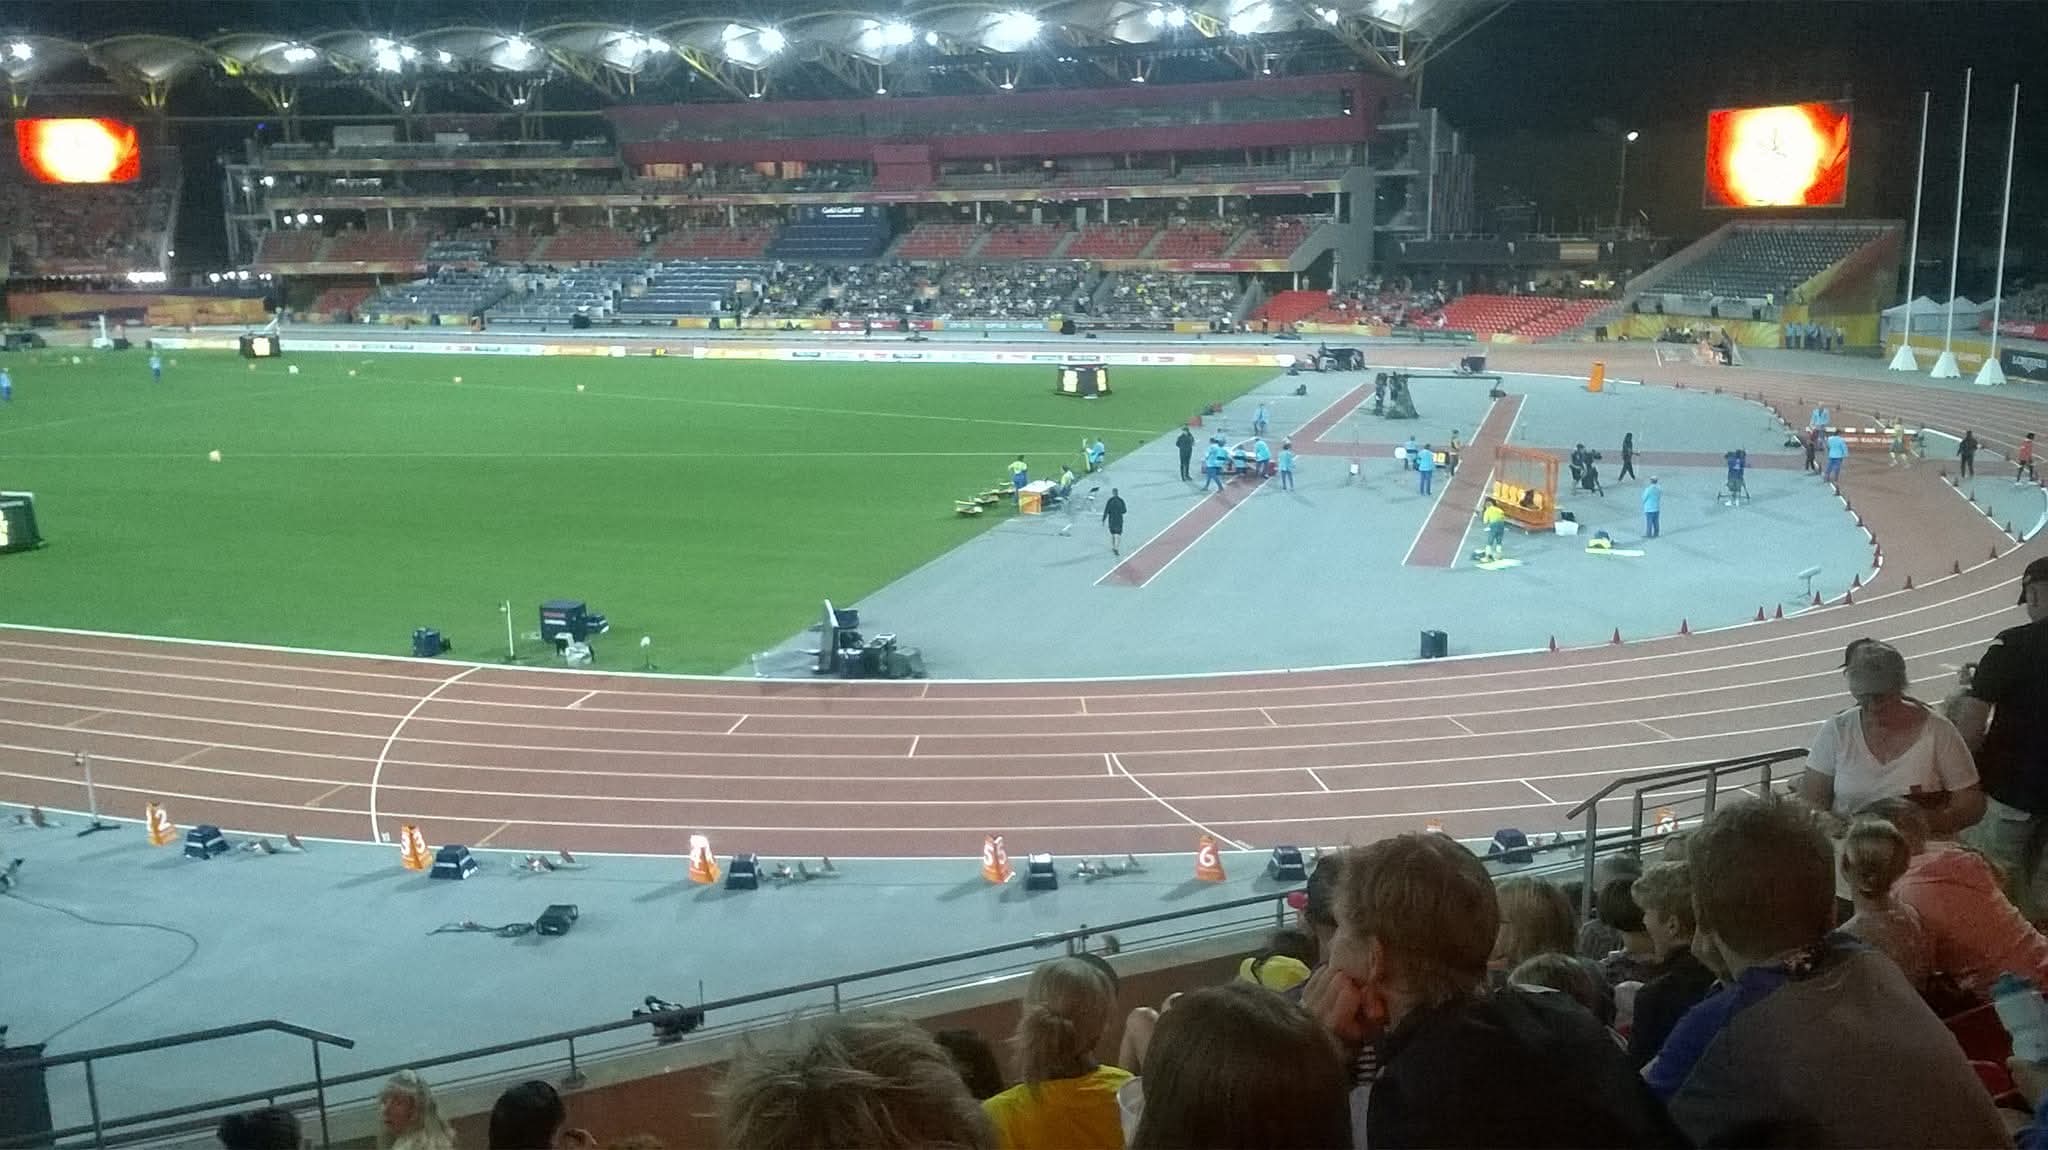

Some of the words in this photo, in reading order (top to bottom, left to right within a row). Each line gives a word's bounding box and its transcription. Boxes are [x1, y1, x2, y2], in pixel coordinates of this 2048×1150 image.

[155, 809, 171, 832] 2
[983, 842, 994, 866] 5
[1199, 845, 1216, 867] 6
